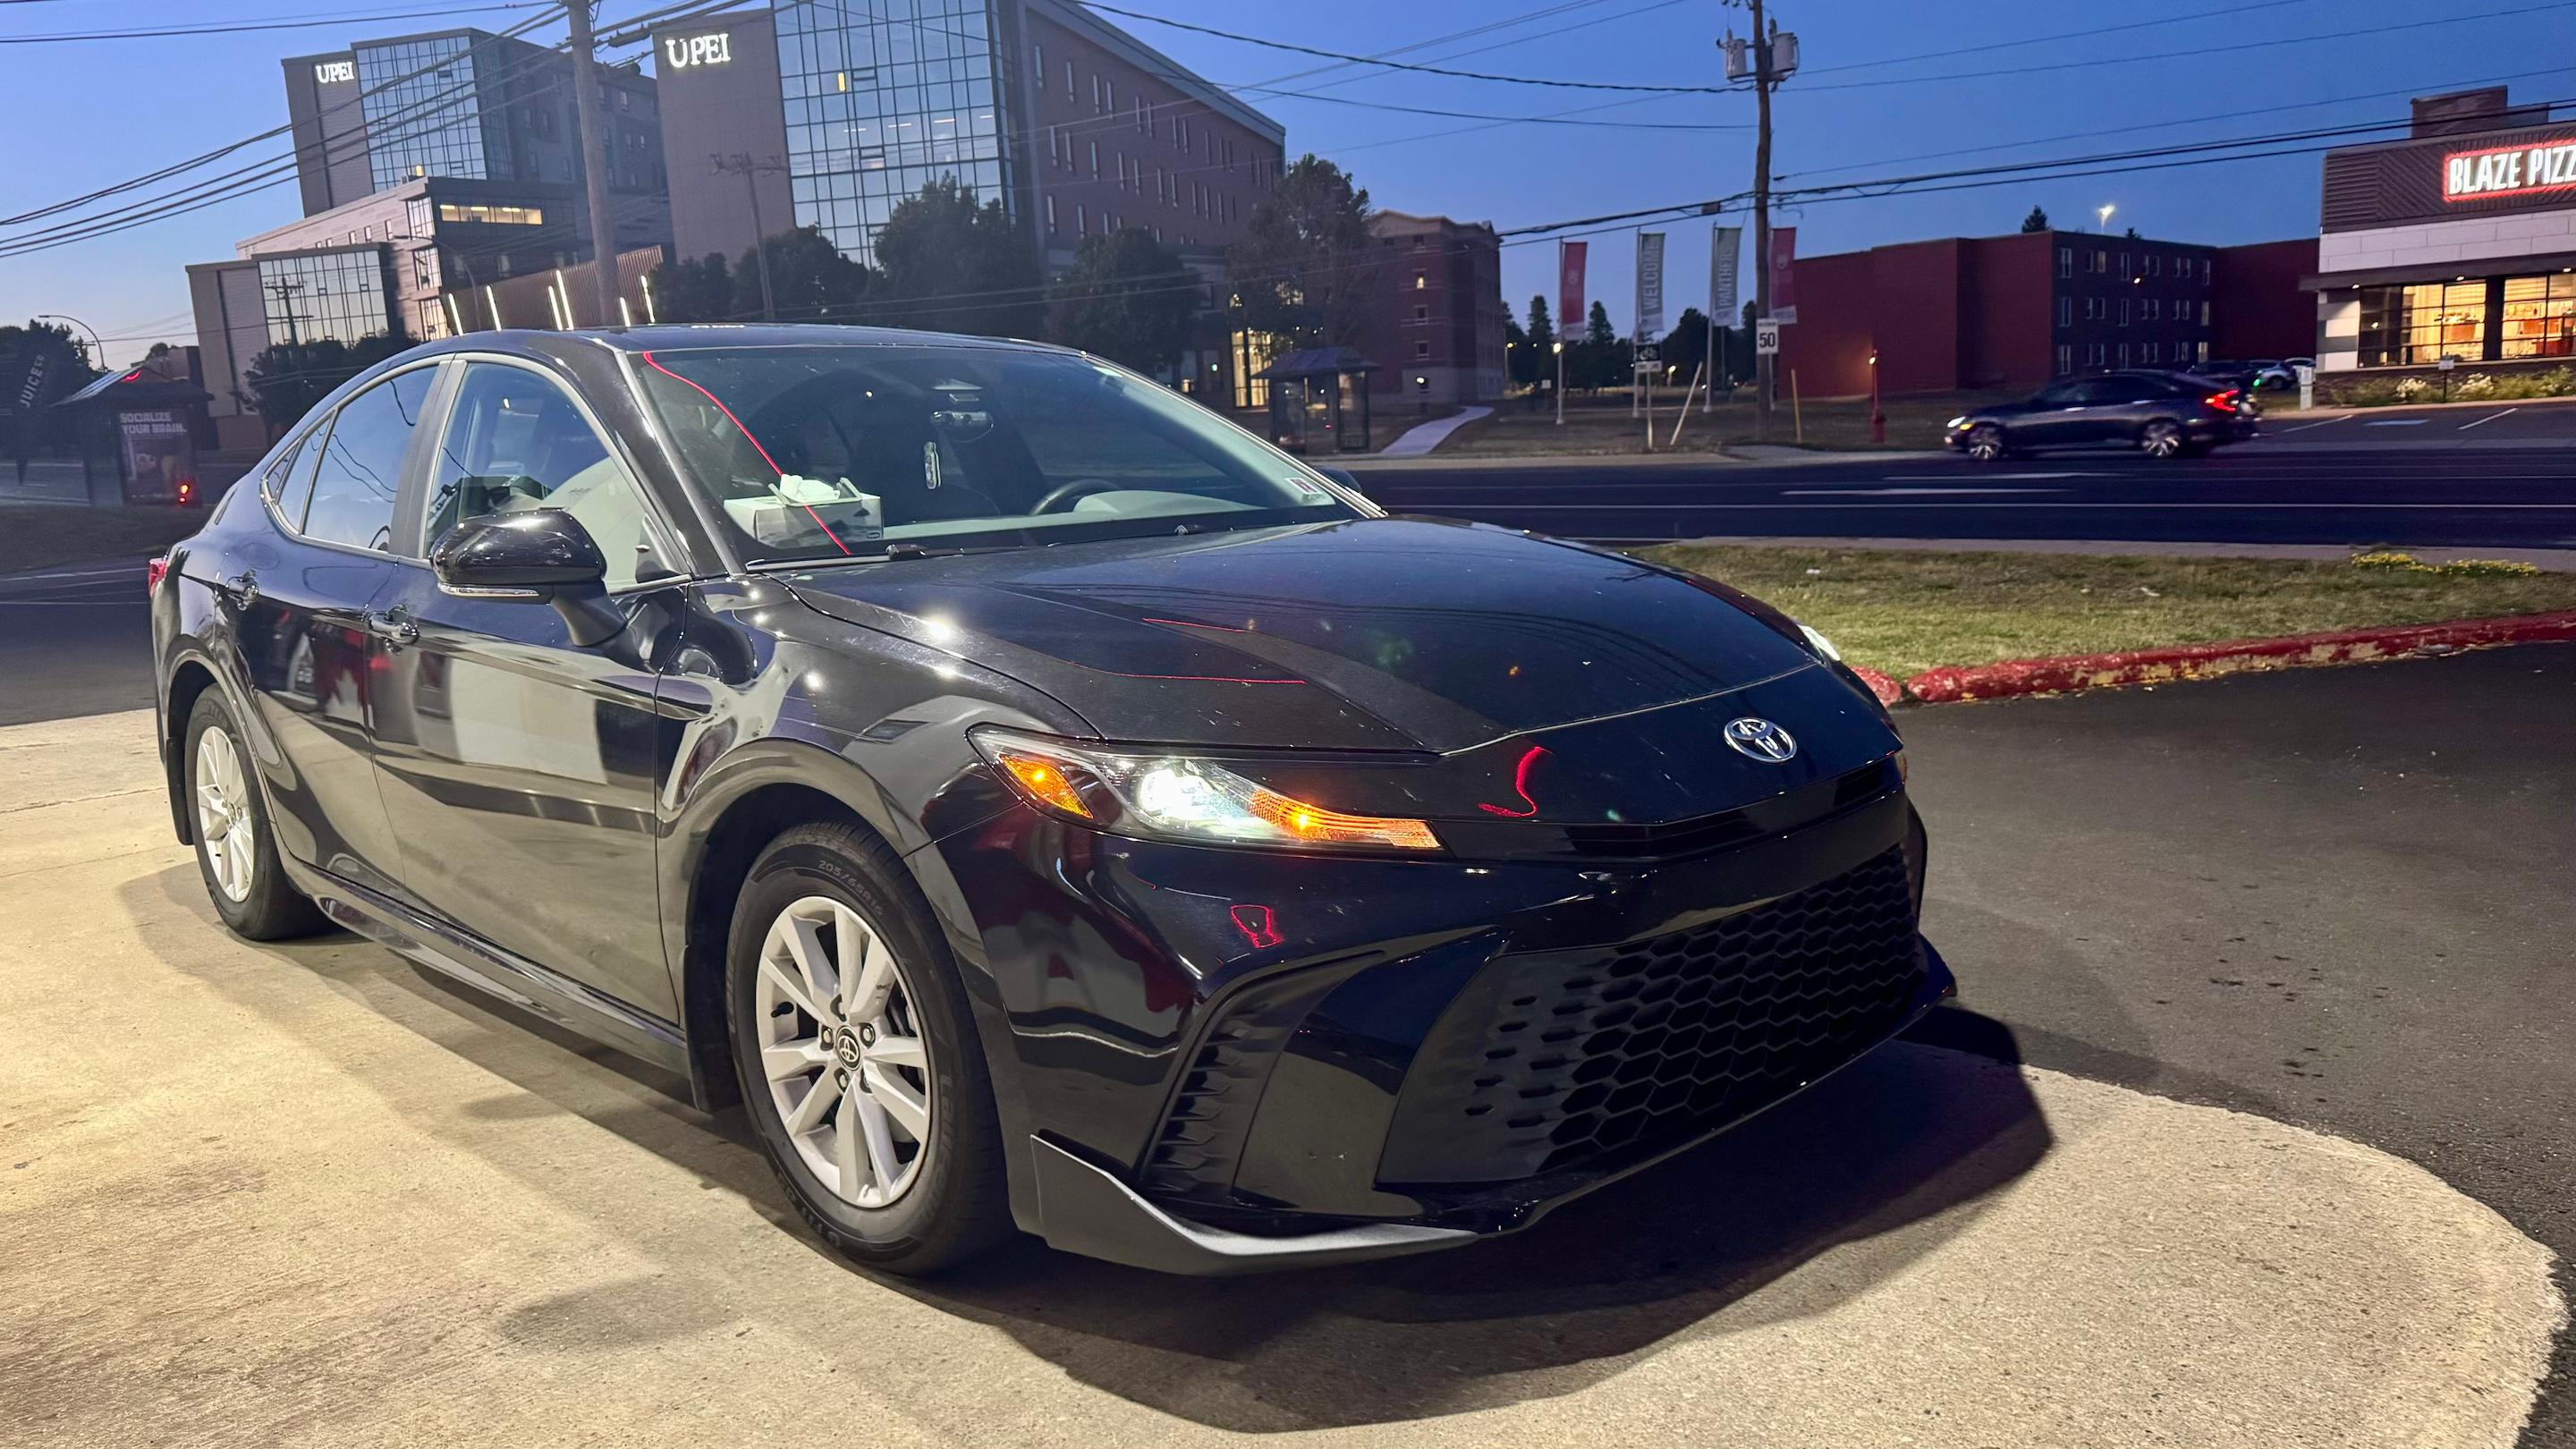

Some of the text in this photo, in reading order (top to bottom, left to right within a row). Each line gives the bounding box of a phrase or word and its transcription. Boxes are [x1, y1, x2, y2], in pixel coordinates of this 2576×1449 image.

[665, 33, 732, 68] UPEI
[315, 61, 355, 83] UPEI
[2448, 152, 2521, 194] BLAZE
[1643, 242, 1660, 309] WELCOME
[1718, 244, 1733, 307] PANTHERS
[1758, 332, 1775, 348] 50
[121, 412, 172, 423] SOCIALIZE
[122, 424, 150, 435] YOUR
